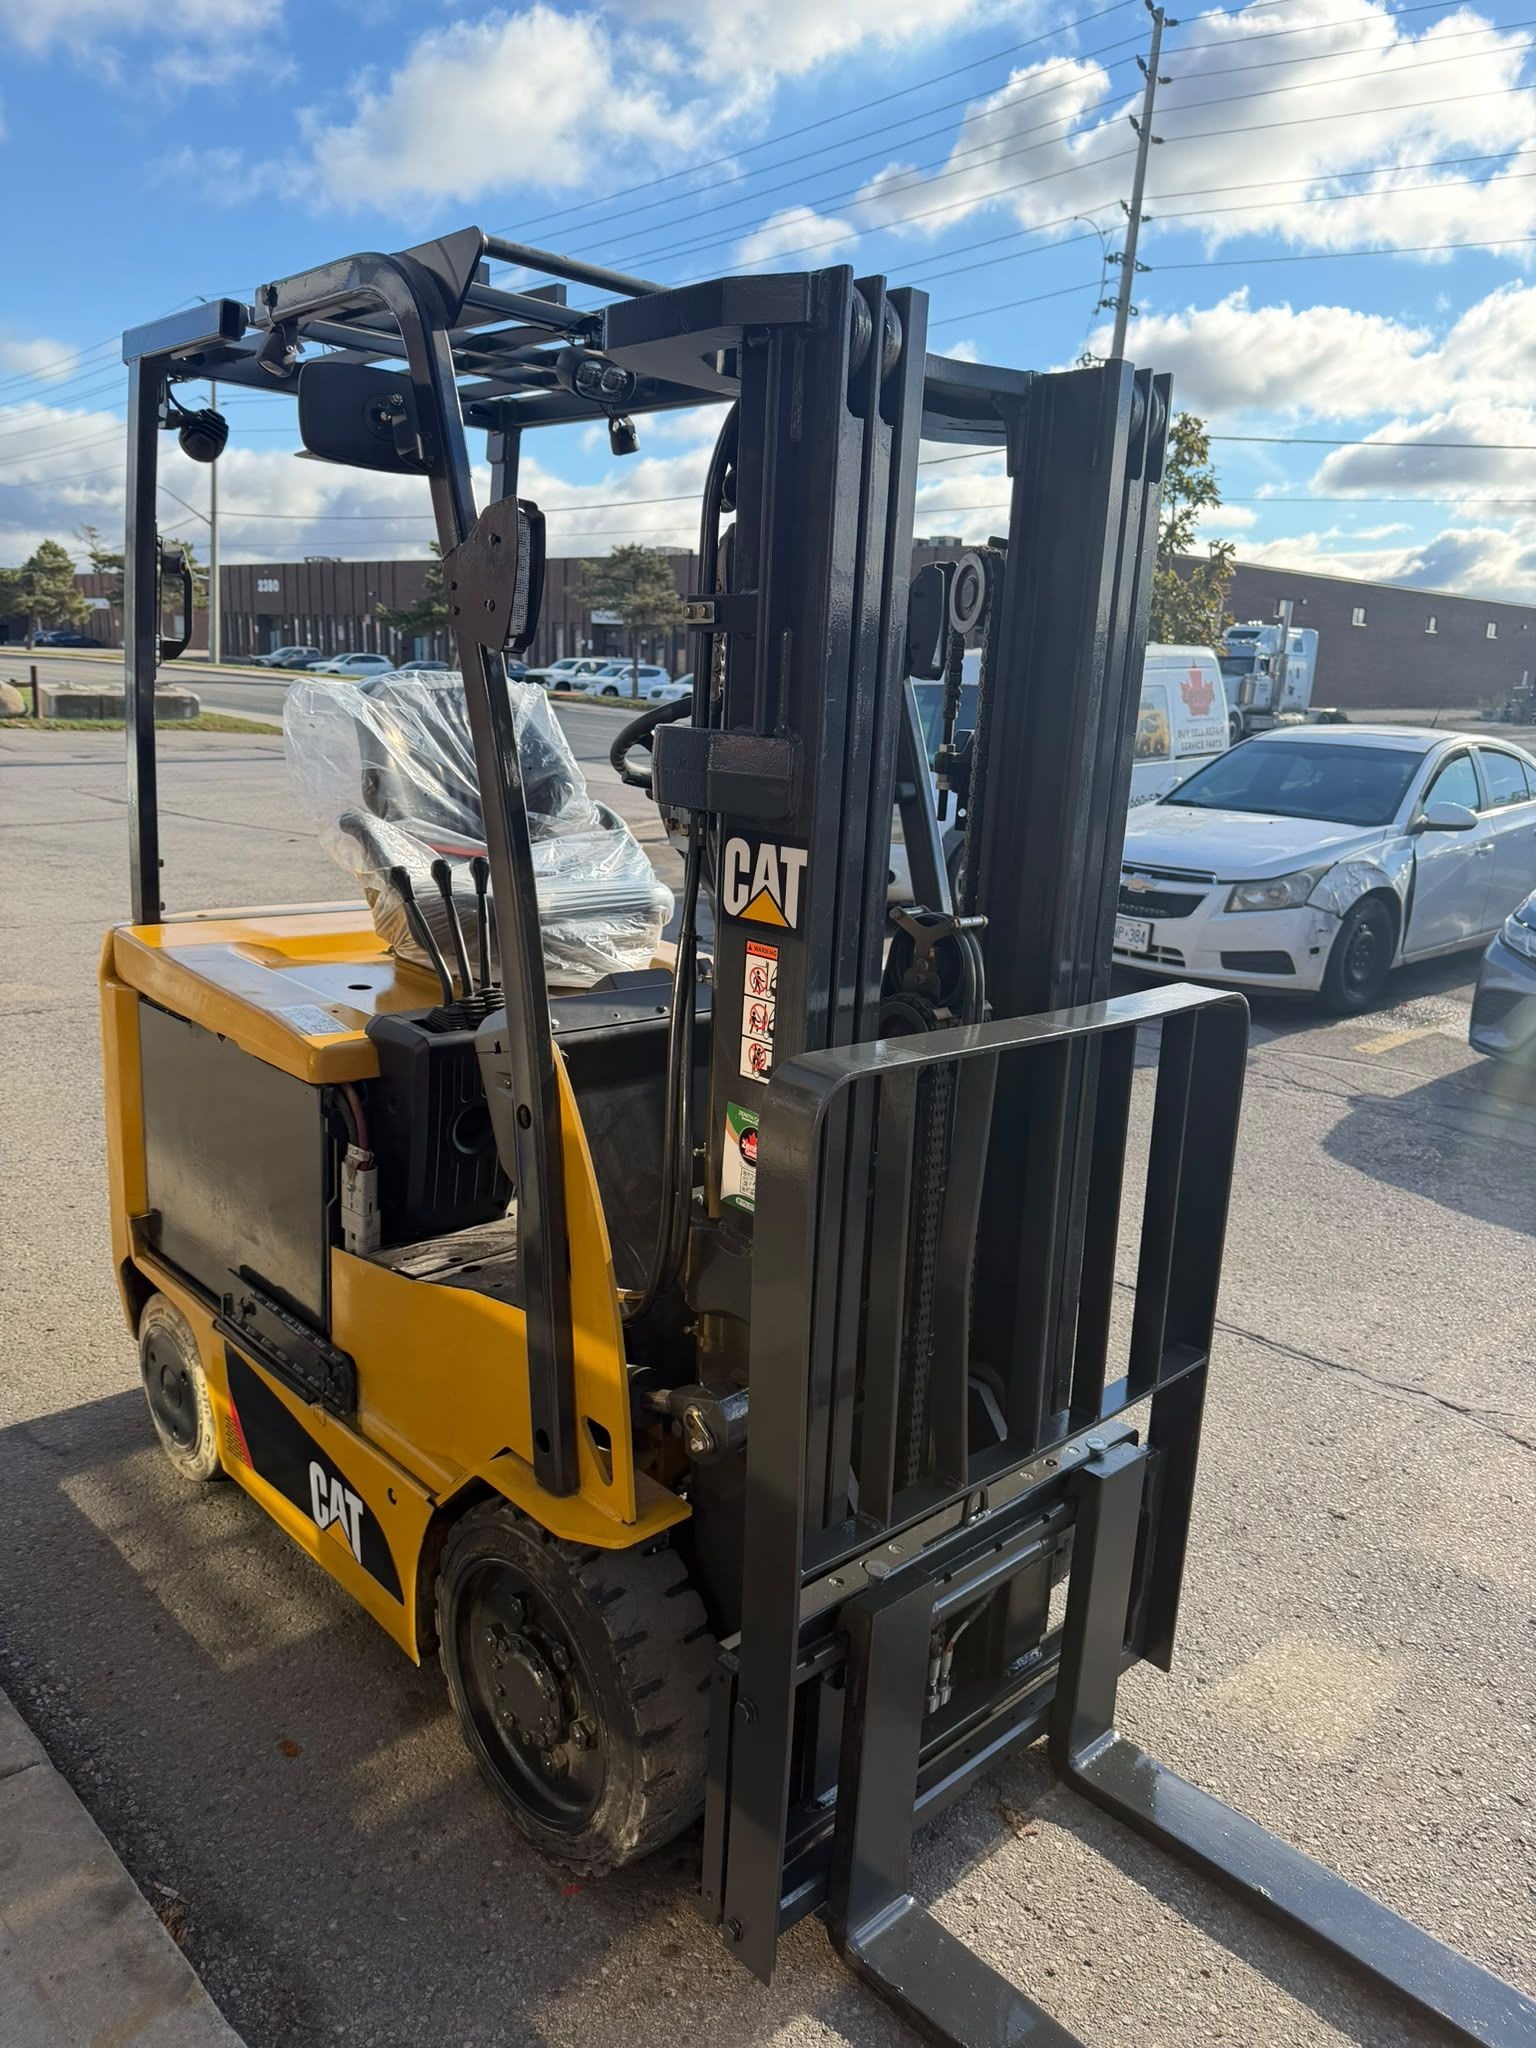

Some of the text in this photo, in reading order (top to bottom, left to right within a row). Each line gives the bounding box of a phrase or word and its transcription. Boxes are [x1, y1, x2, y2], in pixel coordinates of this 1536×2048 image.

[1180, 741, 1204, 752] SERVICE
[723, 837, 808, 929] CAT
[309, 1461, 364, 1564] CAT
